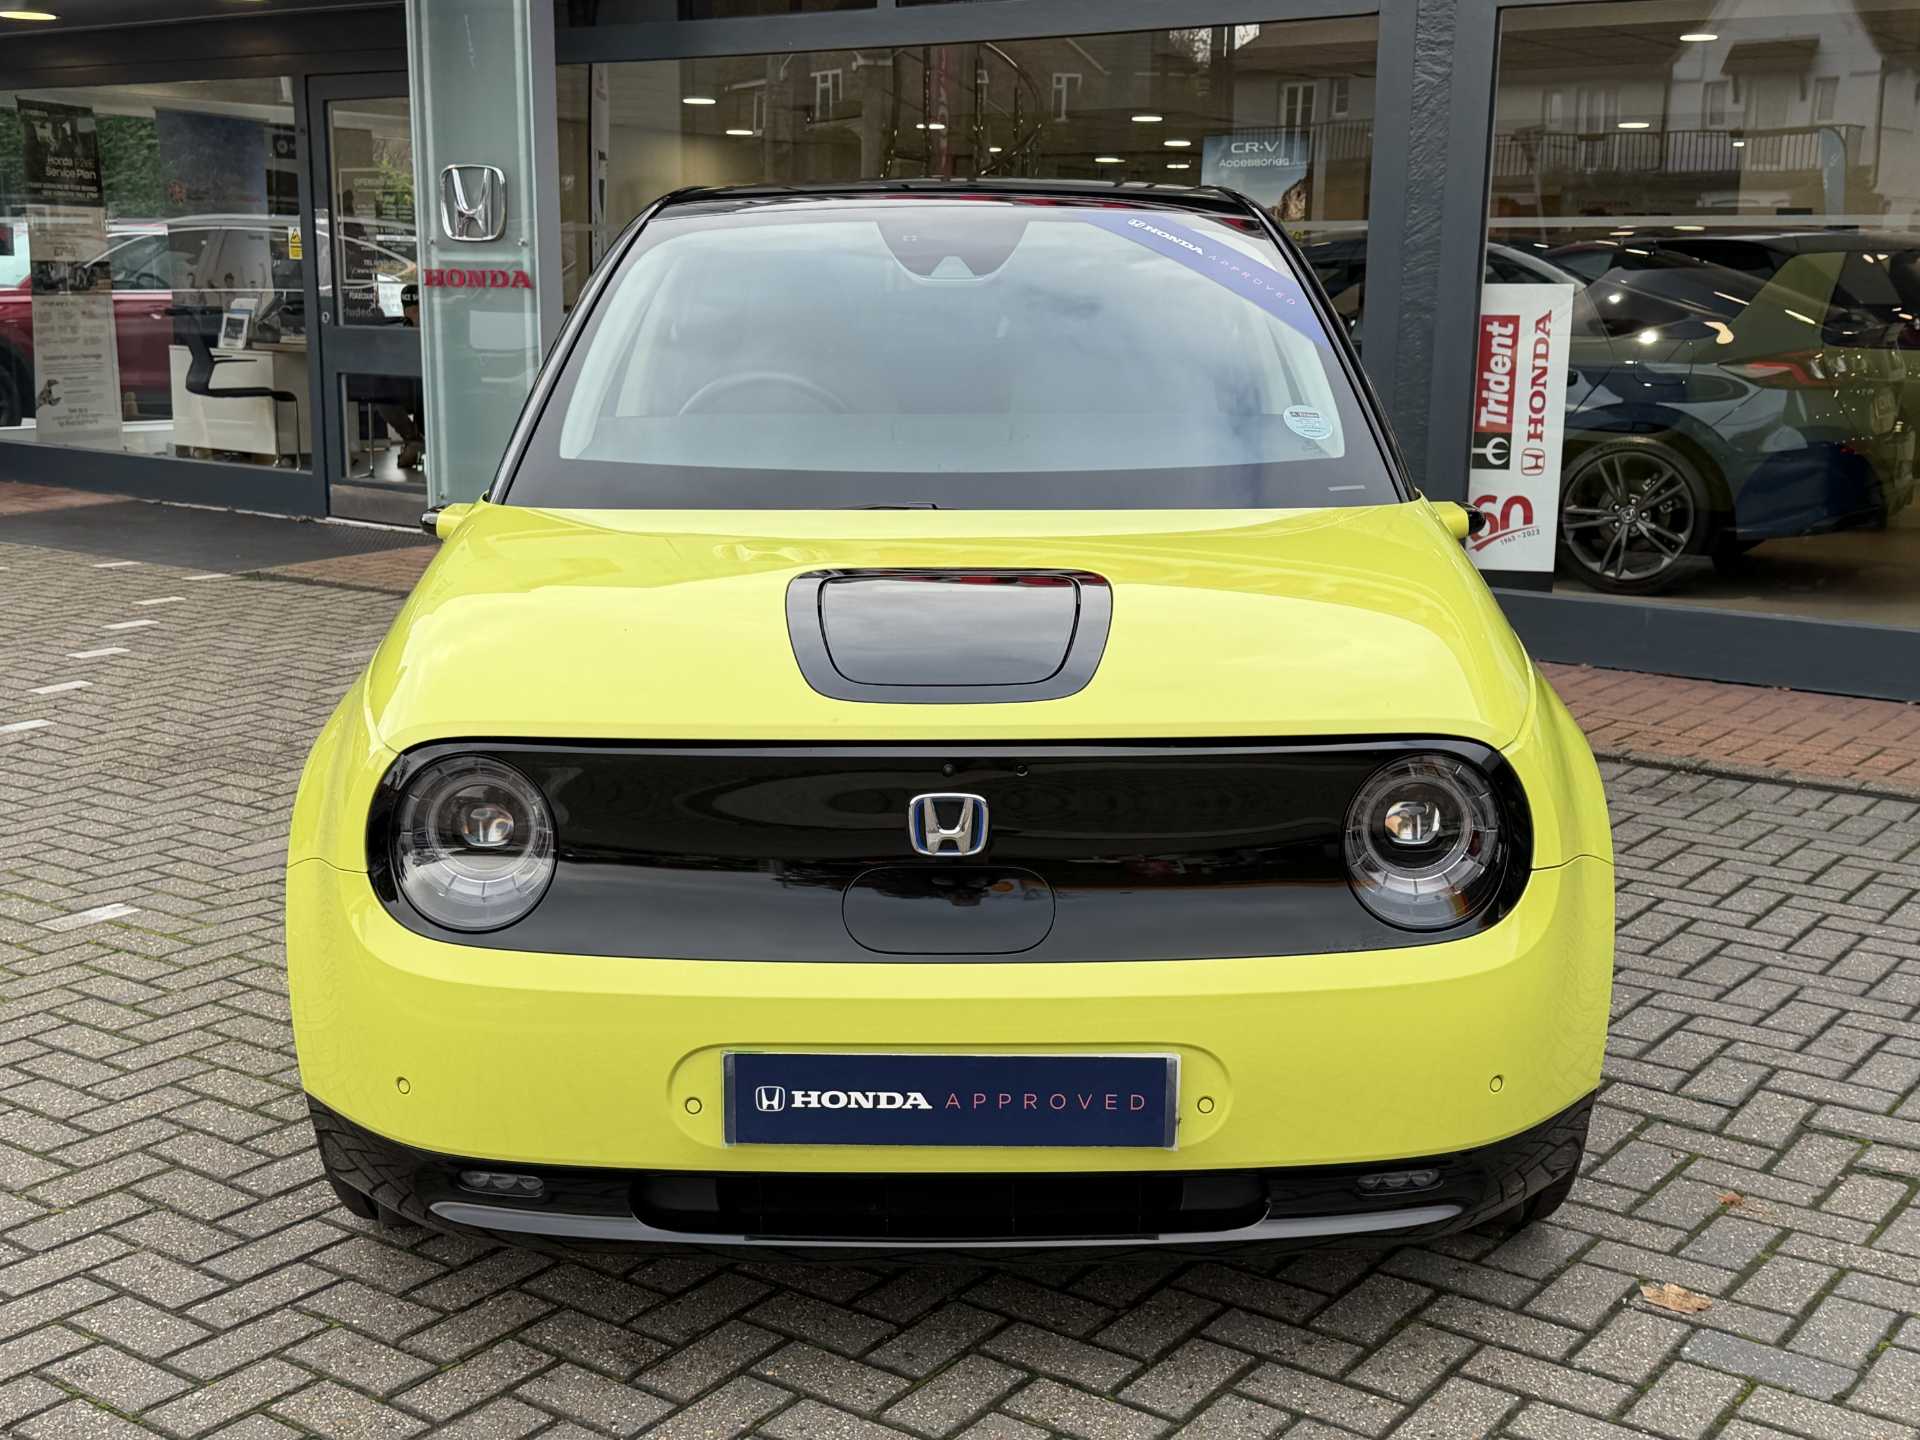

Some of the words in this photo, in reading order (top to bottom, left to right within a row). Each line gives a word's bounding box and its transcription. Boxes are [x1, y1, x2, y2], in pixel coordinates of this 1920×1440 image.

[424, 268, 535, 289] HONDA
[1143, 225, 1204, 256] HONDA
[1208, 255, 1296, 305] APPROVED
[1479, 321, 1514, 428] Trident
[1527, 309, 1552, 443] HONDA
[791, 1090, 933, 1109] HONDA
[945, 1092, 1145, 1110] APPROVED
